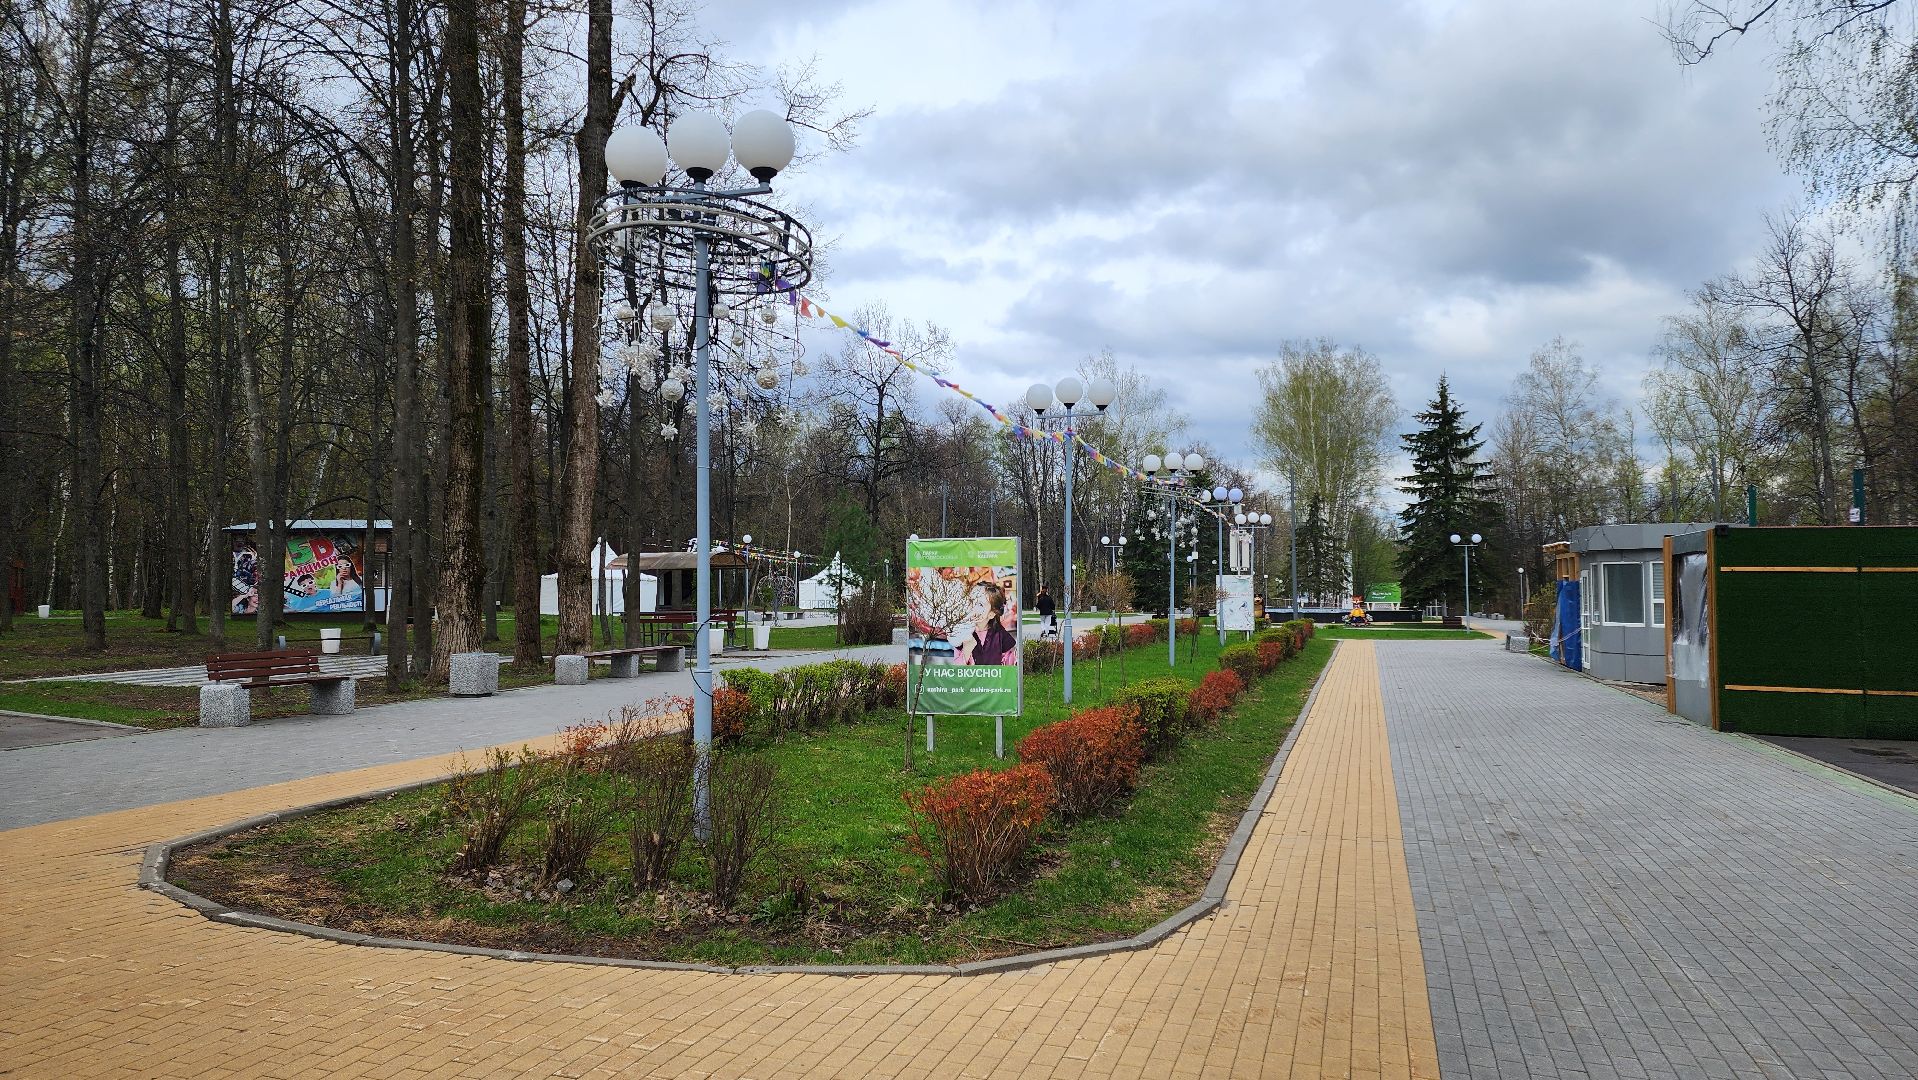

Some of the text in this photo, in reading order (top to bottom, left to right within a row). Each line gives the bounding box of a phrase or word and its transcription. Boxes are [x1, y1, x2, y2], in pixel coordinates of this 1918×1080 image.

[287, 536, 335, 566] 5D
[283, 556, 338, 580] РАКЦИОН
[924, 668, 1002, 678] У НАС ВКУСНО!
